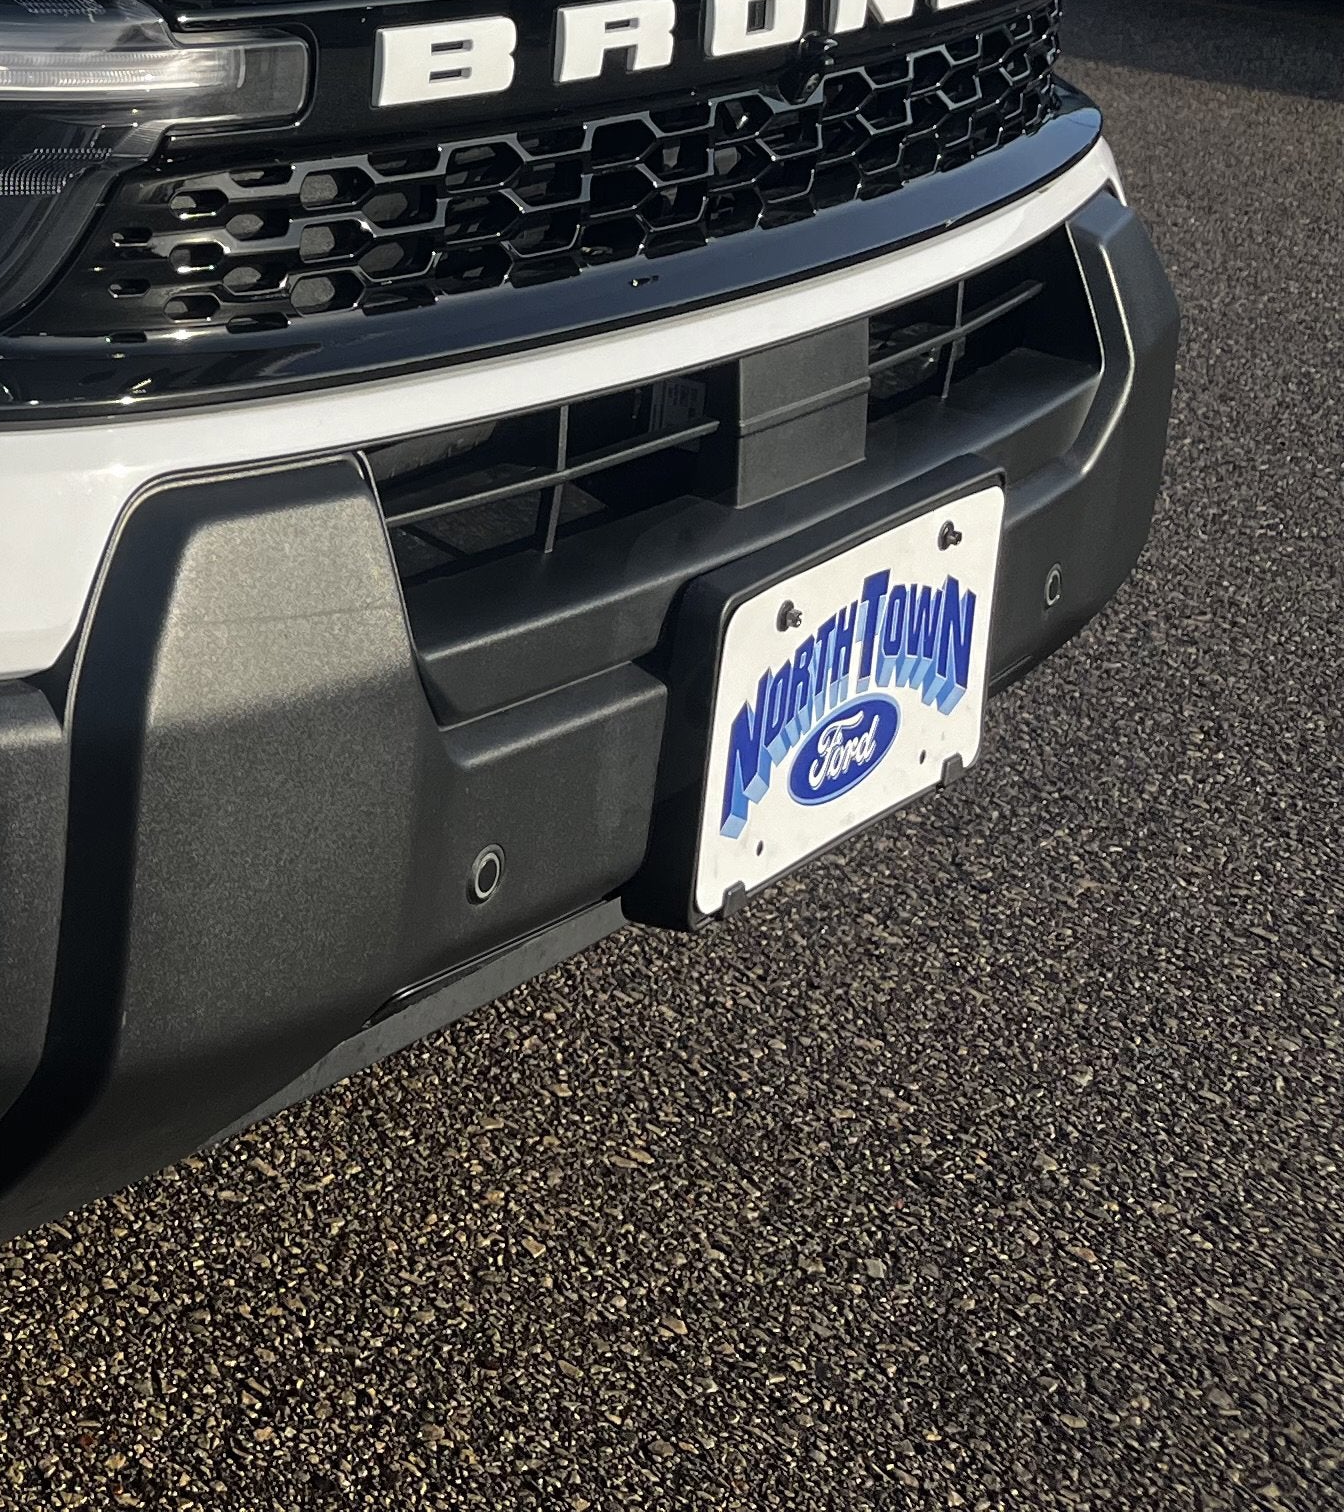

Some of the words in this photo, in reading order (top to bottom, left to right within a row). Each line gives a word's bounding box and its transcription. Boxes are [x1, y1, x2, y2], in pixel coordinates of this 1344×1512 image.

[719, 599, 860, 839] NORTH
[854, 568, 977, 716] TOWN
[808, 709, 880, 790] Ford
